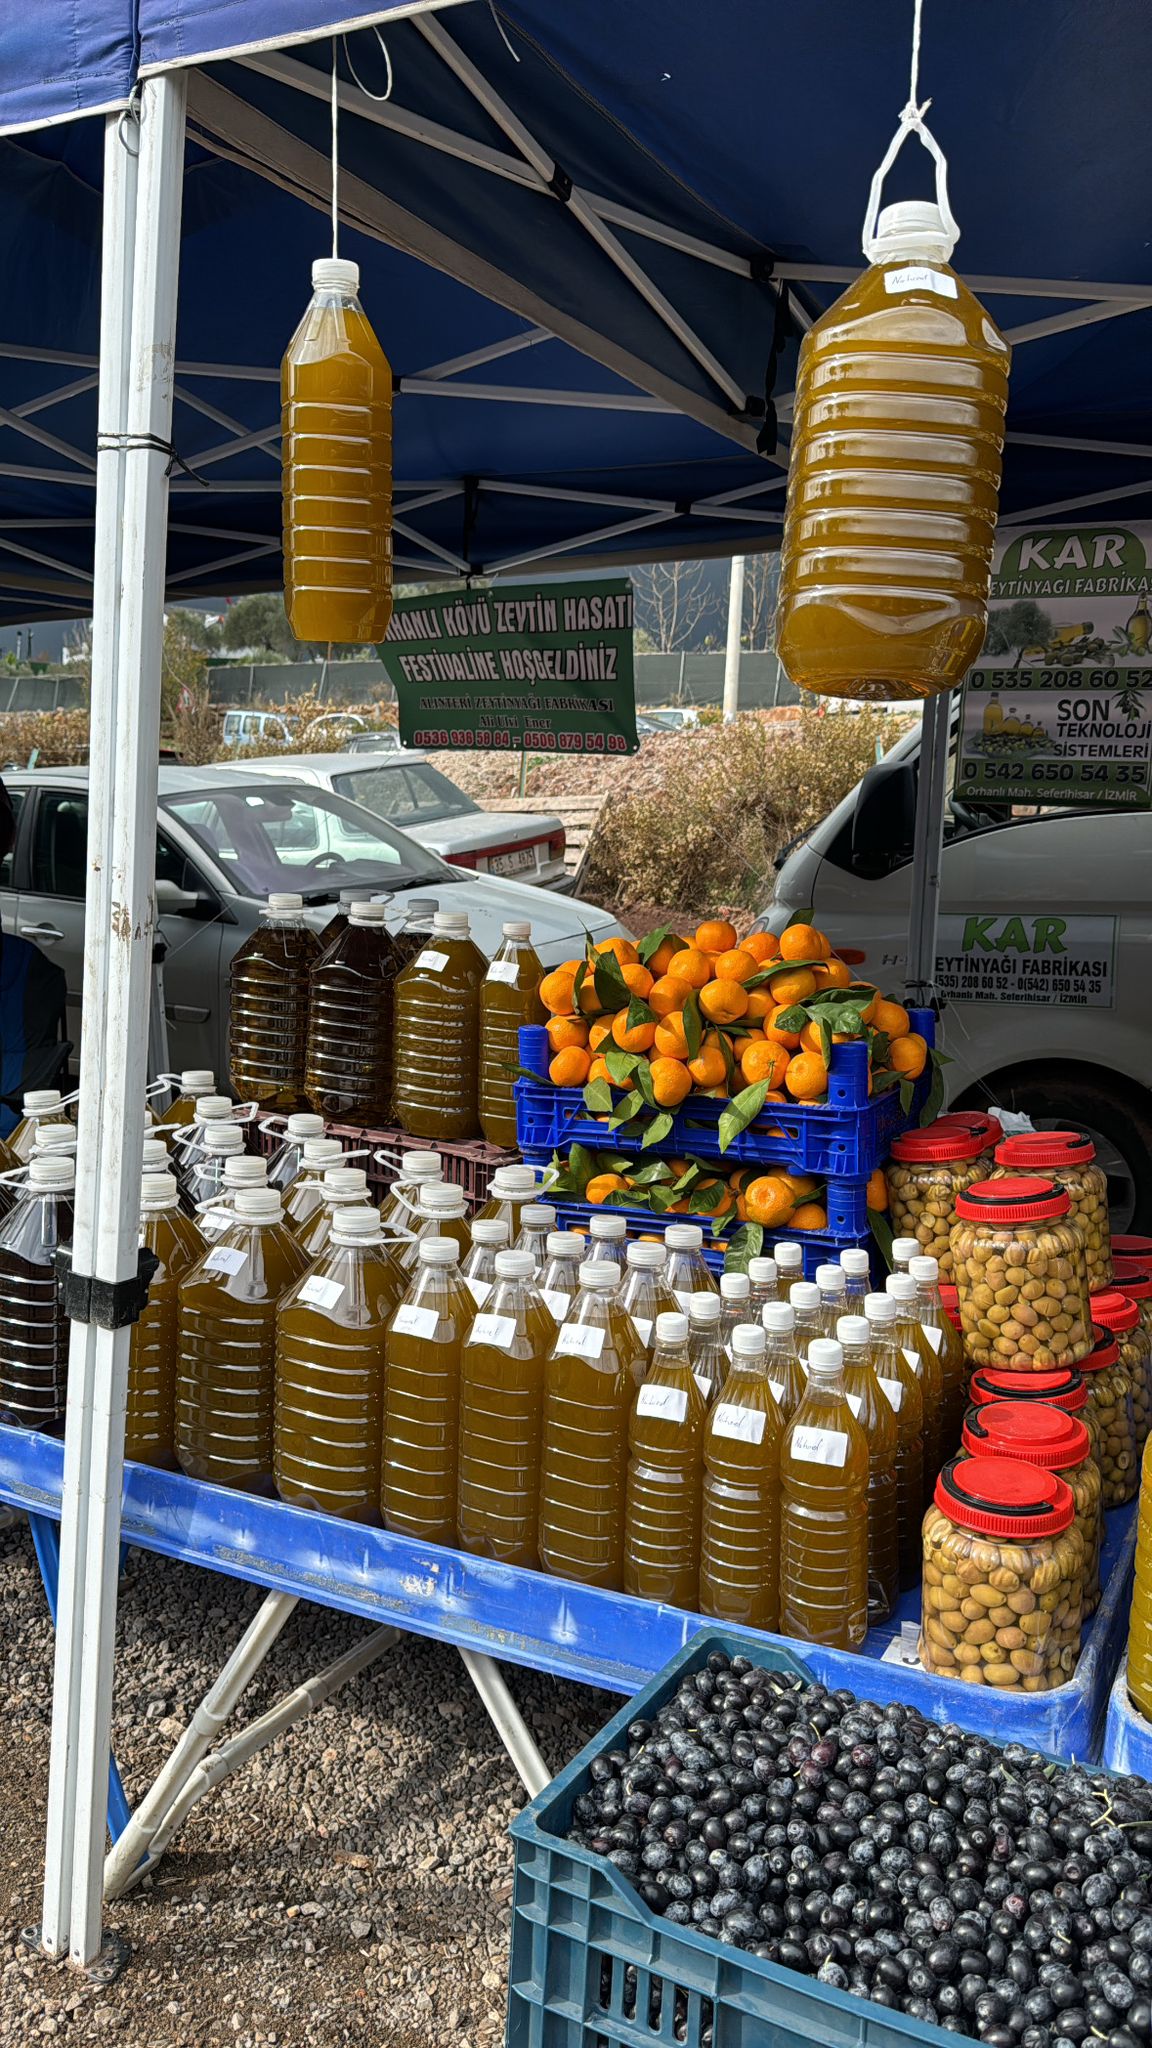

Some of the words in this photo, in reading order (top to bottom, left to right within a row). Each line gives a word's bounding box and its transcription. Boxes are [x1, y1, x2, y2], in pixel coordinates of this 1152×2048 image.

[1018, 534, 1127, 572] KAR
[442, 599, 491, 637] KÖYÜ
[494, 594, 558, 633] ZEYTİN
[563, 594, 634, 631] HASATI
[399, 646, 501, 682] FESTİVALİNE
[500, 641, 617, 686] HOŞGELDİNİZ
[971, 671, 985, 688] 0
[991, 671, 1033, 688] 535
[1040, 670, 1083, 688] 208
[1089, 670, 1119, 688] 60
[1126, 669, 1152, 687] 52
[1057, 699, 1110, 721] SON
[1056, 720, 1152, 739] TEKNOLOJİ
[585, 732, 604, 750] 54
[606, 733, 627, 751] 98
[1053, 741, 1149, 758] SİSTEMLERİ
[964, 762, 977, 779] 0
[984, 762, 1024, 780] 542
[1031, 763, 1074, 780] 650
[1081, 764, 1109, 782] 54
[1116, 765, 1145, 783] 35
[1007, 787, 1034, 798] Mah.
[1037, 788, 1095, 800] Seferihisar
[1105, 788, 1137, 801] İZMİR
[961, 916, 1068, 954] KAR
[935, 953, 1017, 974] EYTİNYAĞI
[1022, 956, 1107, 977] FABRİKASI
[961, 976, 979, 988] 208
[982, 976, 994, 989] 60
[996, 976, 1008, 989] 52
[1017, 977, 1049, 992] 0(542)
[1052, 979, 1071, 992] 650
[1073, 979, 1086, 993] 54
[1088, 980, 1102, 993] 35
